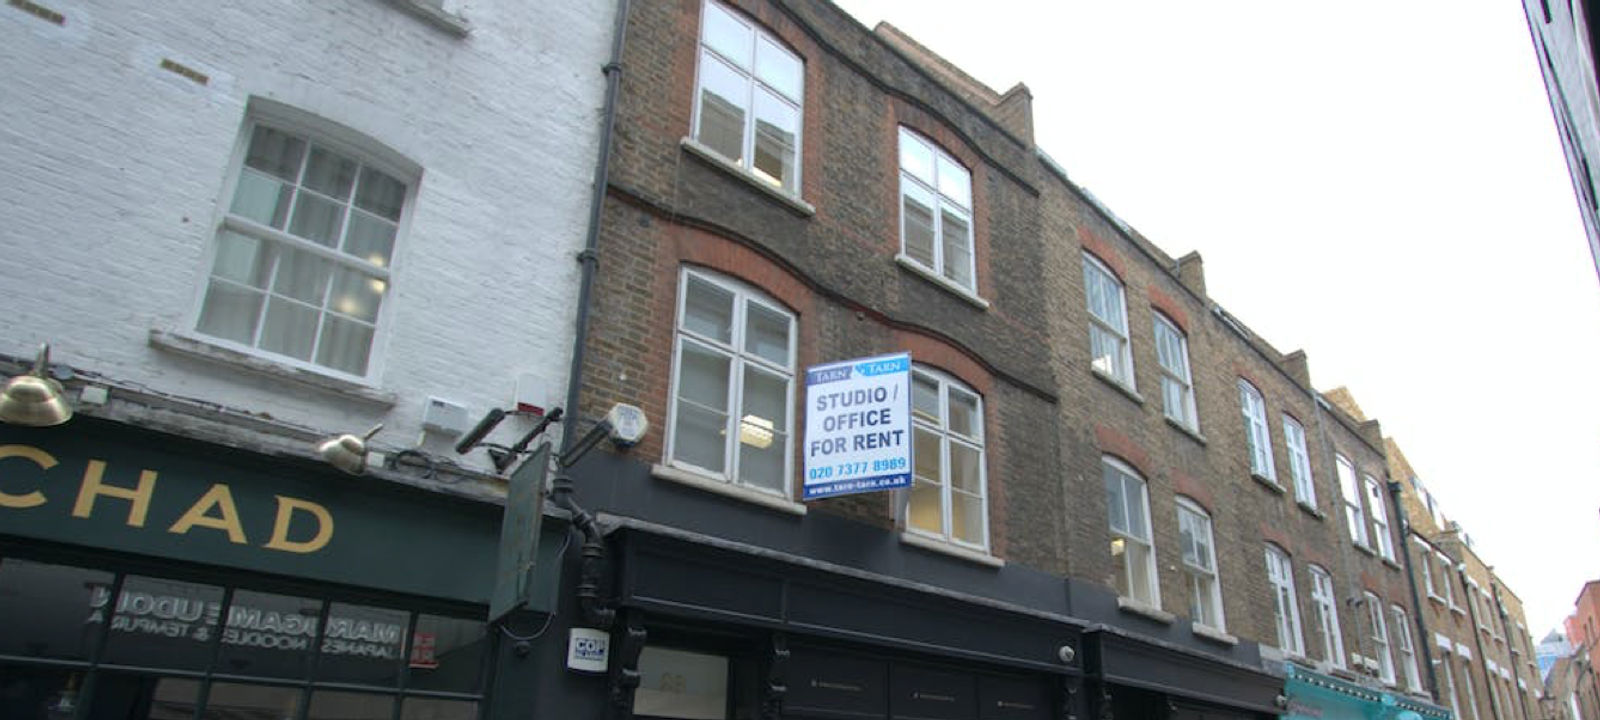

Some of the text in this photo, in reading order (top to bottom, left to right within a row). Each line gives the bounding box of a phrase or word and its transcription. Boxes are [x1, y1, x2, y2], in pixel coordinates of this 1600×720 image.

[816, 361, 900, 384] TARN TARN
[817, 384, 898, 411] STUDIO /
[823, 409, 891, 432] OFFICE
[811, 430, 904, 457] FOR RENT
[809, 457, 906, 480] 020 7377 8989
